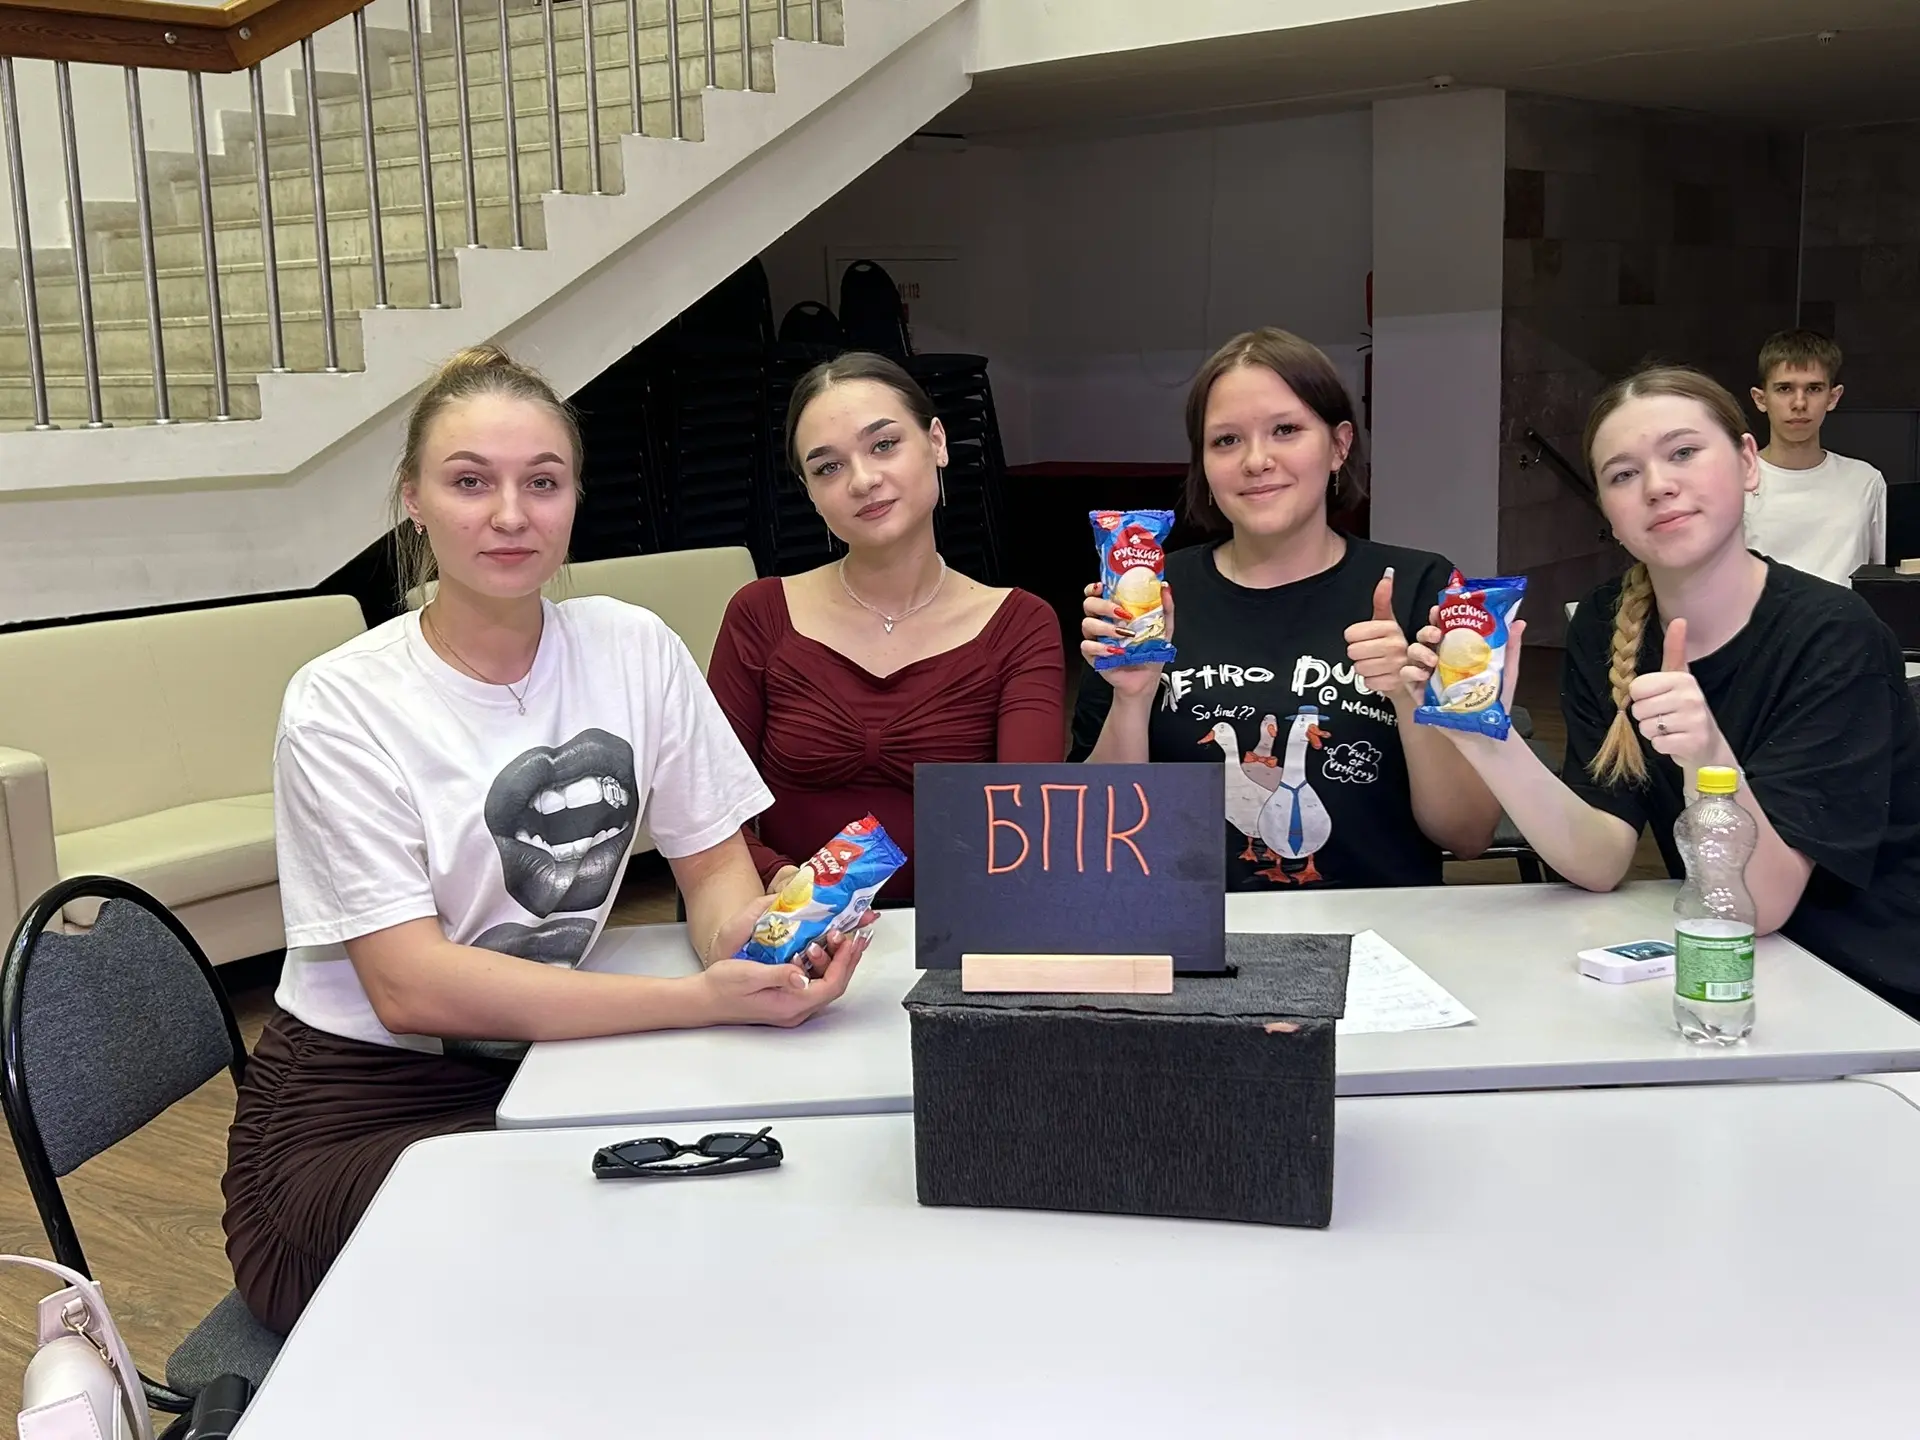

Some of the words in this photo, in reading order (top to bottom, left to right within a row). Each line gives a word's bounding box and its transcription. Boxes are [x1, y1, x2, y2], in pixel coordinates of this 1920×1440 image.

[1440, 604, 1488, 622] РУССКИЙ
[1445, 617, 1483, 630] РАЗМАХ
[1191, 704, 1211, 721] So
[1348, 749, 1371, 762] FULL
[1349, 759, 1365, 767] OF
[984, 782, 1150, 875] БПК
